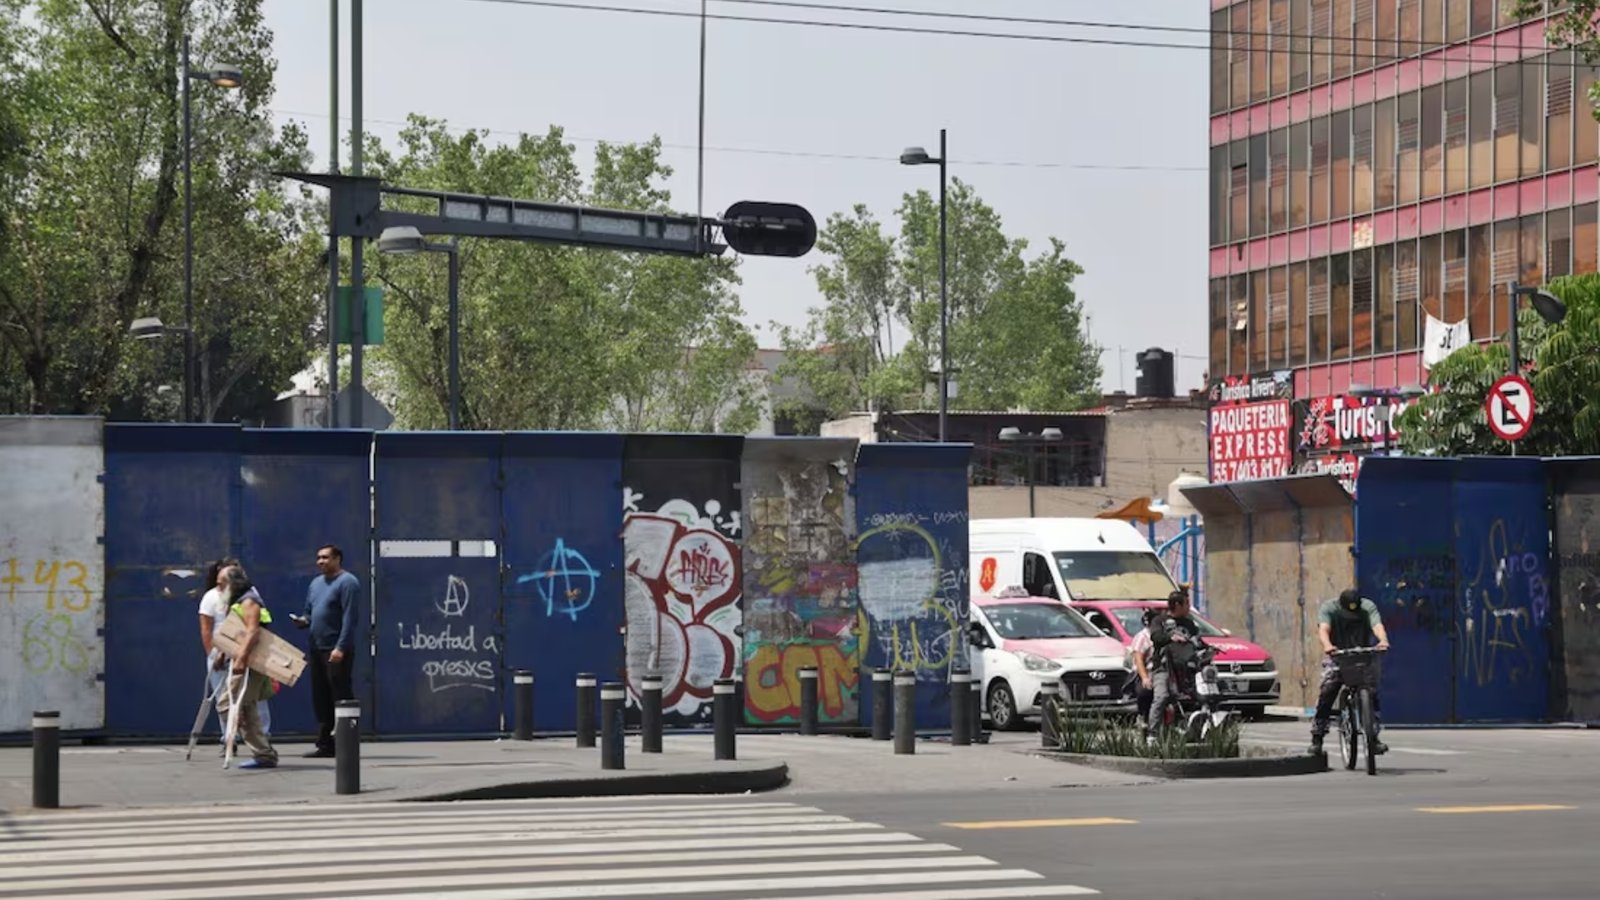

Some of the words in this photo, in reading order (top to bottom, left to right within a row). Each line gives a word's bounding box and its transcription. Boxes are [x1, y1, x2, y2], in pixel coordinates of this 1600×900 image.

[1212, 403, 1287, 434] PAQUETERIA
[1214, 430, 1285, 459] EXPRESS
[23, 613, 89, 675] 68
[398, 623, 477, 652] Libertad
[483, 637, 499, 654] a
